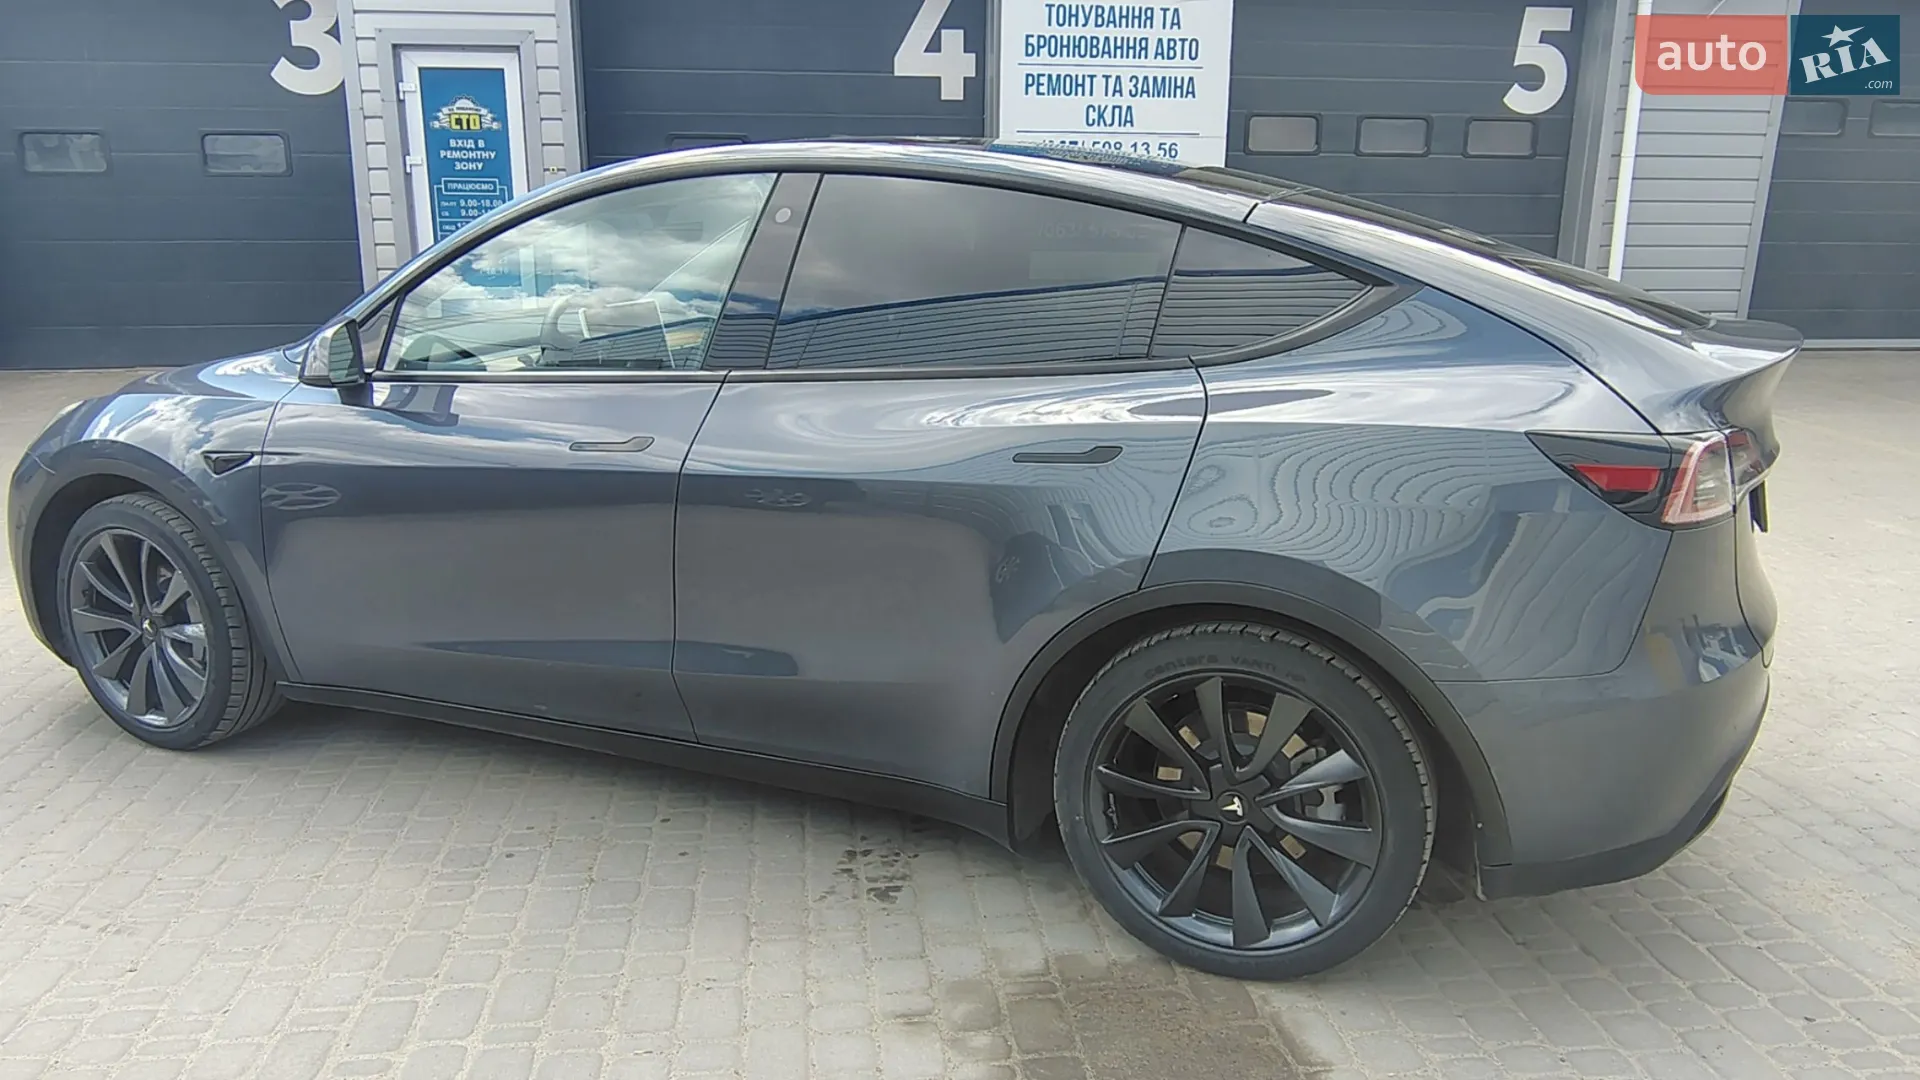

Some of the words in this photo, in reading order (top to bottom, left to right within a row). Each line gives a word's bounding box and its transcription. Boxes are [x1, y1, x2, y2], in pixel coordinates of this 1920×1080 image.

[1045, 4, 1153, 30] ТОНУВАННЯ
[1160, 8, 1182, 30] ТА
[271, 0, 346, 95] 3
[894, 0, 976, 100] 4
[1024, 34, 1149, 60] БРОНЮВАННЯ
[1153, 37, 1200, 61] АВТО
[1503, 6, 1573, 115] 5
[1024, 73, 1097, 97] РЕМОНТ
[1102, 75, 1124, 98] ТА
[1129, 76, 1197, 99] ЗАМІНА
[450, 114, 481, 130] СТО
[1085, 105, 1135, 128] СКЛА
[440, 150, 496, 159] РЕМОНТНУ
[449, 139, 475, 149] ВХІД
[478, 139, 485, 148] В
[454, 161, 484, 170] ЗОНУ
